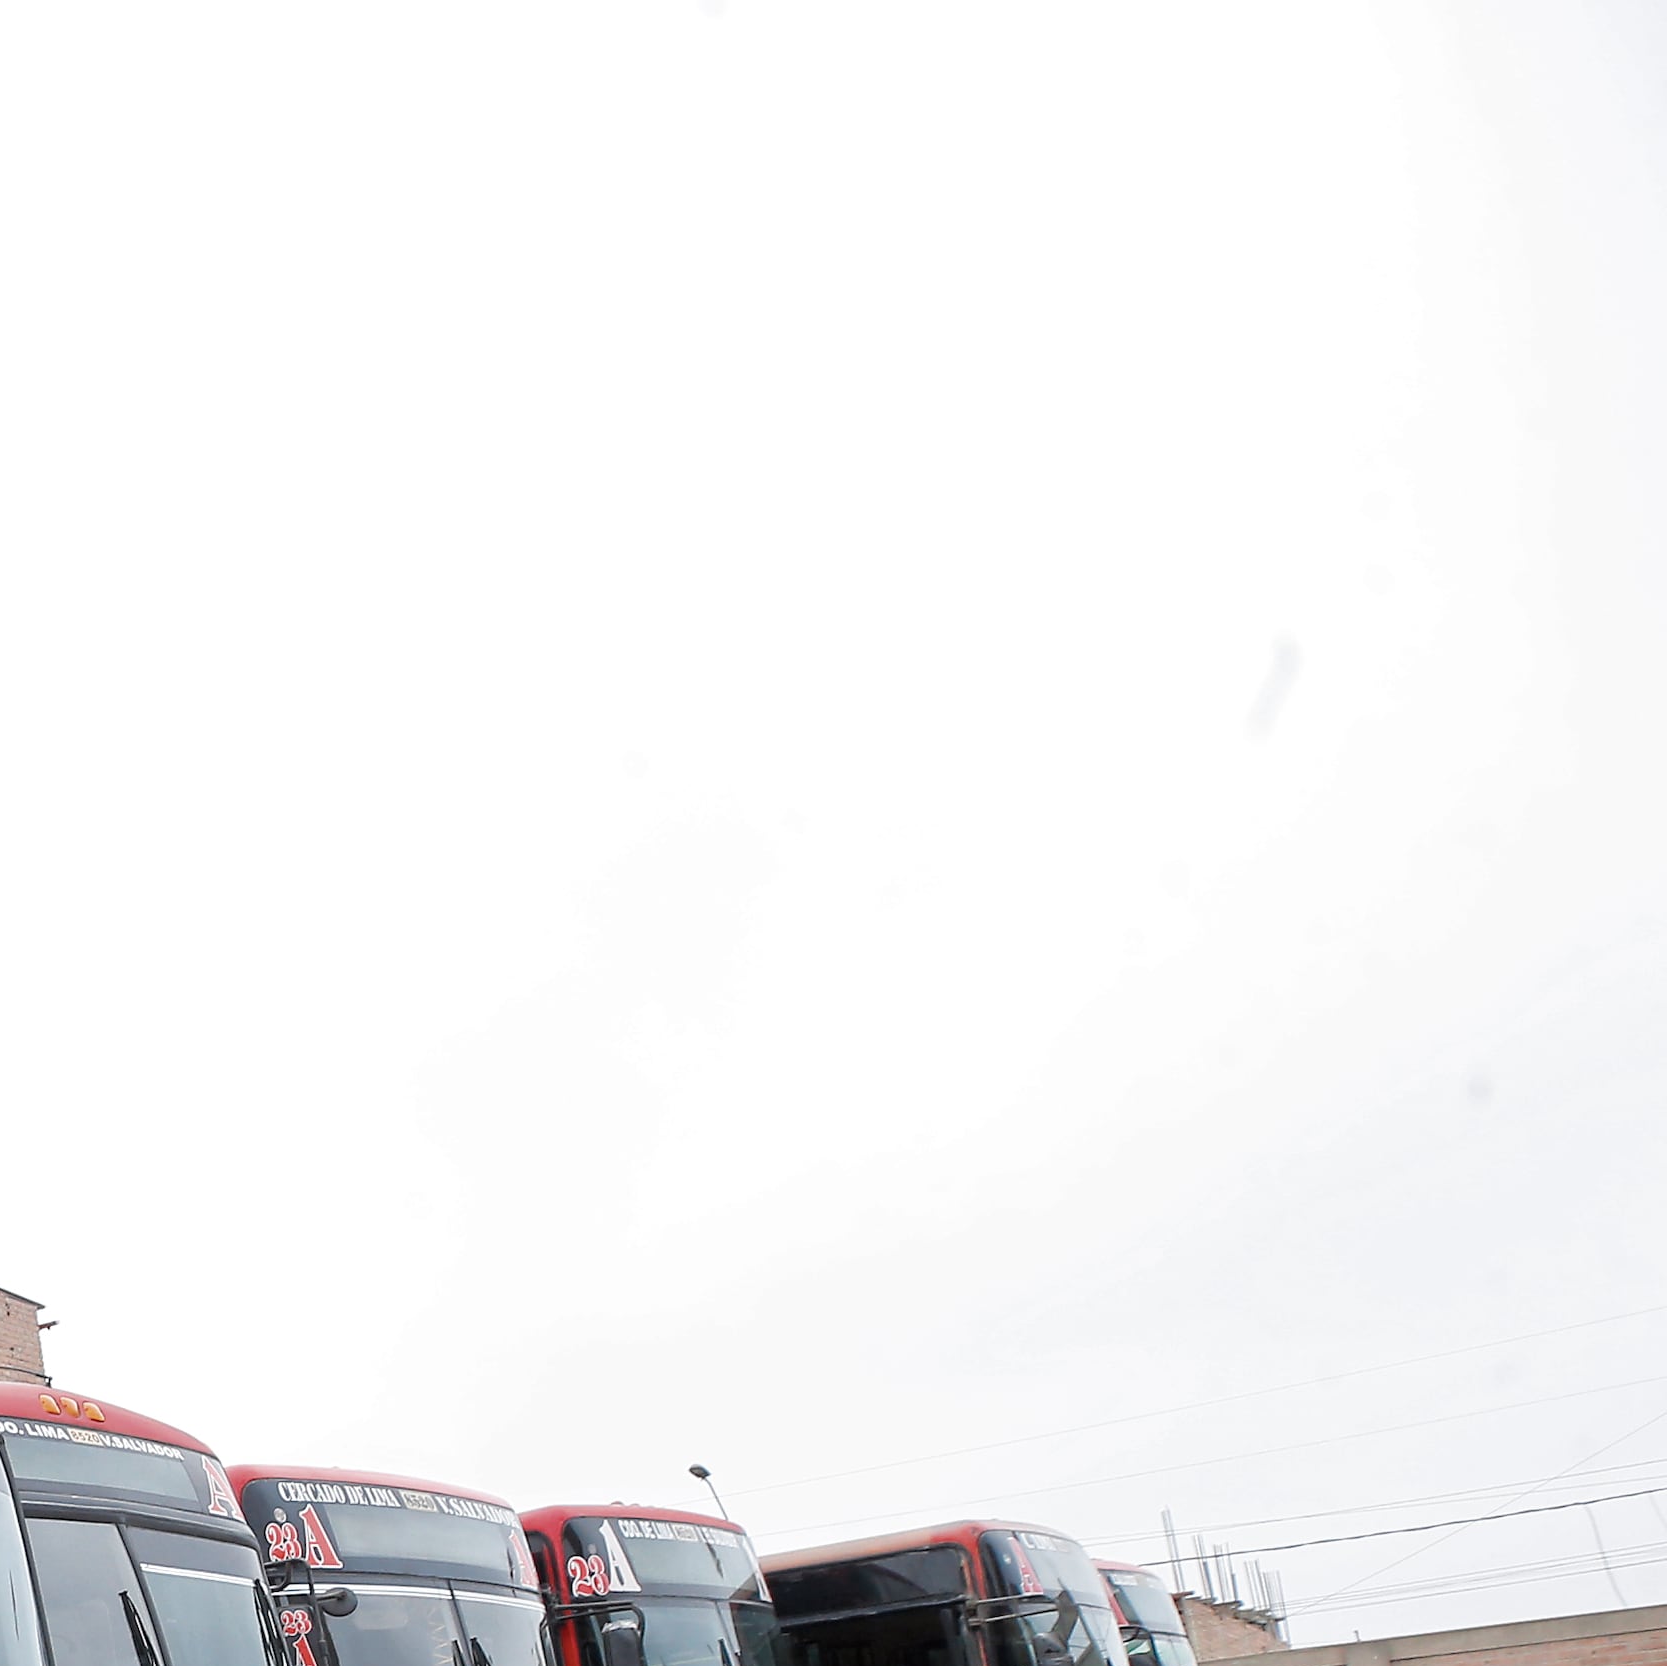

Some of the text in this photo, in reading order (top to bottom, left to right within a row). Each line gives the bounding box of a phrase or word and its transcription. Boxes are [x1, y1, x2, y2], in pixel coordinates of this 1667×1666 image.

[25, 1423, 69, 1441] LIMA
[202, 1455, 246, 1523] A
[277, 1481, 345, 1504] CERCADO
[344, 1485, 366, 1505] DE
[364, 1487, 402, 1508] LIMA
[265, 1522, 302, 1561] 23
[299, 1503, 344, 1569] A
[599, 1519, 642, 1592] A
[567, 1555, 610, 1598] 23
[280, 1609, 313, 1637] 23
